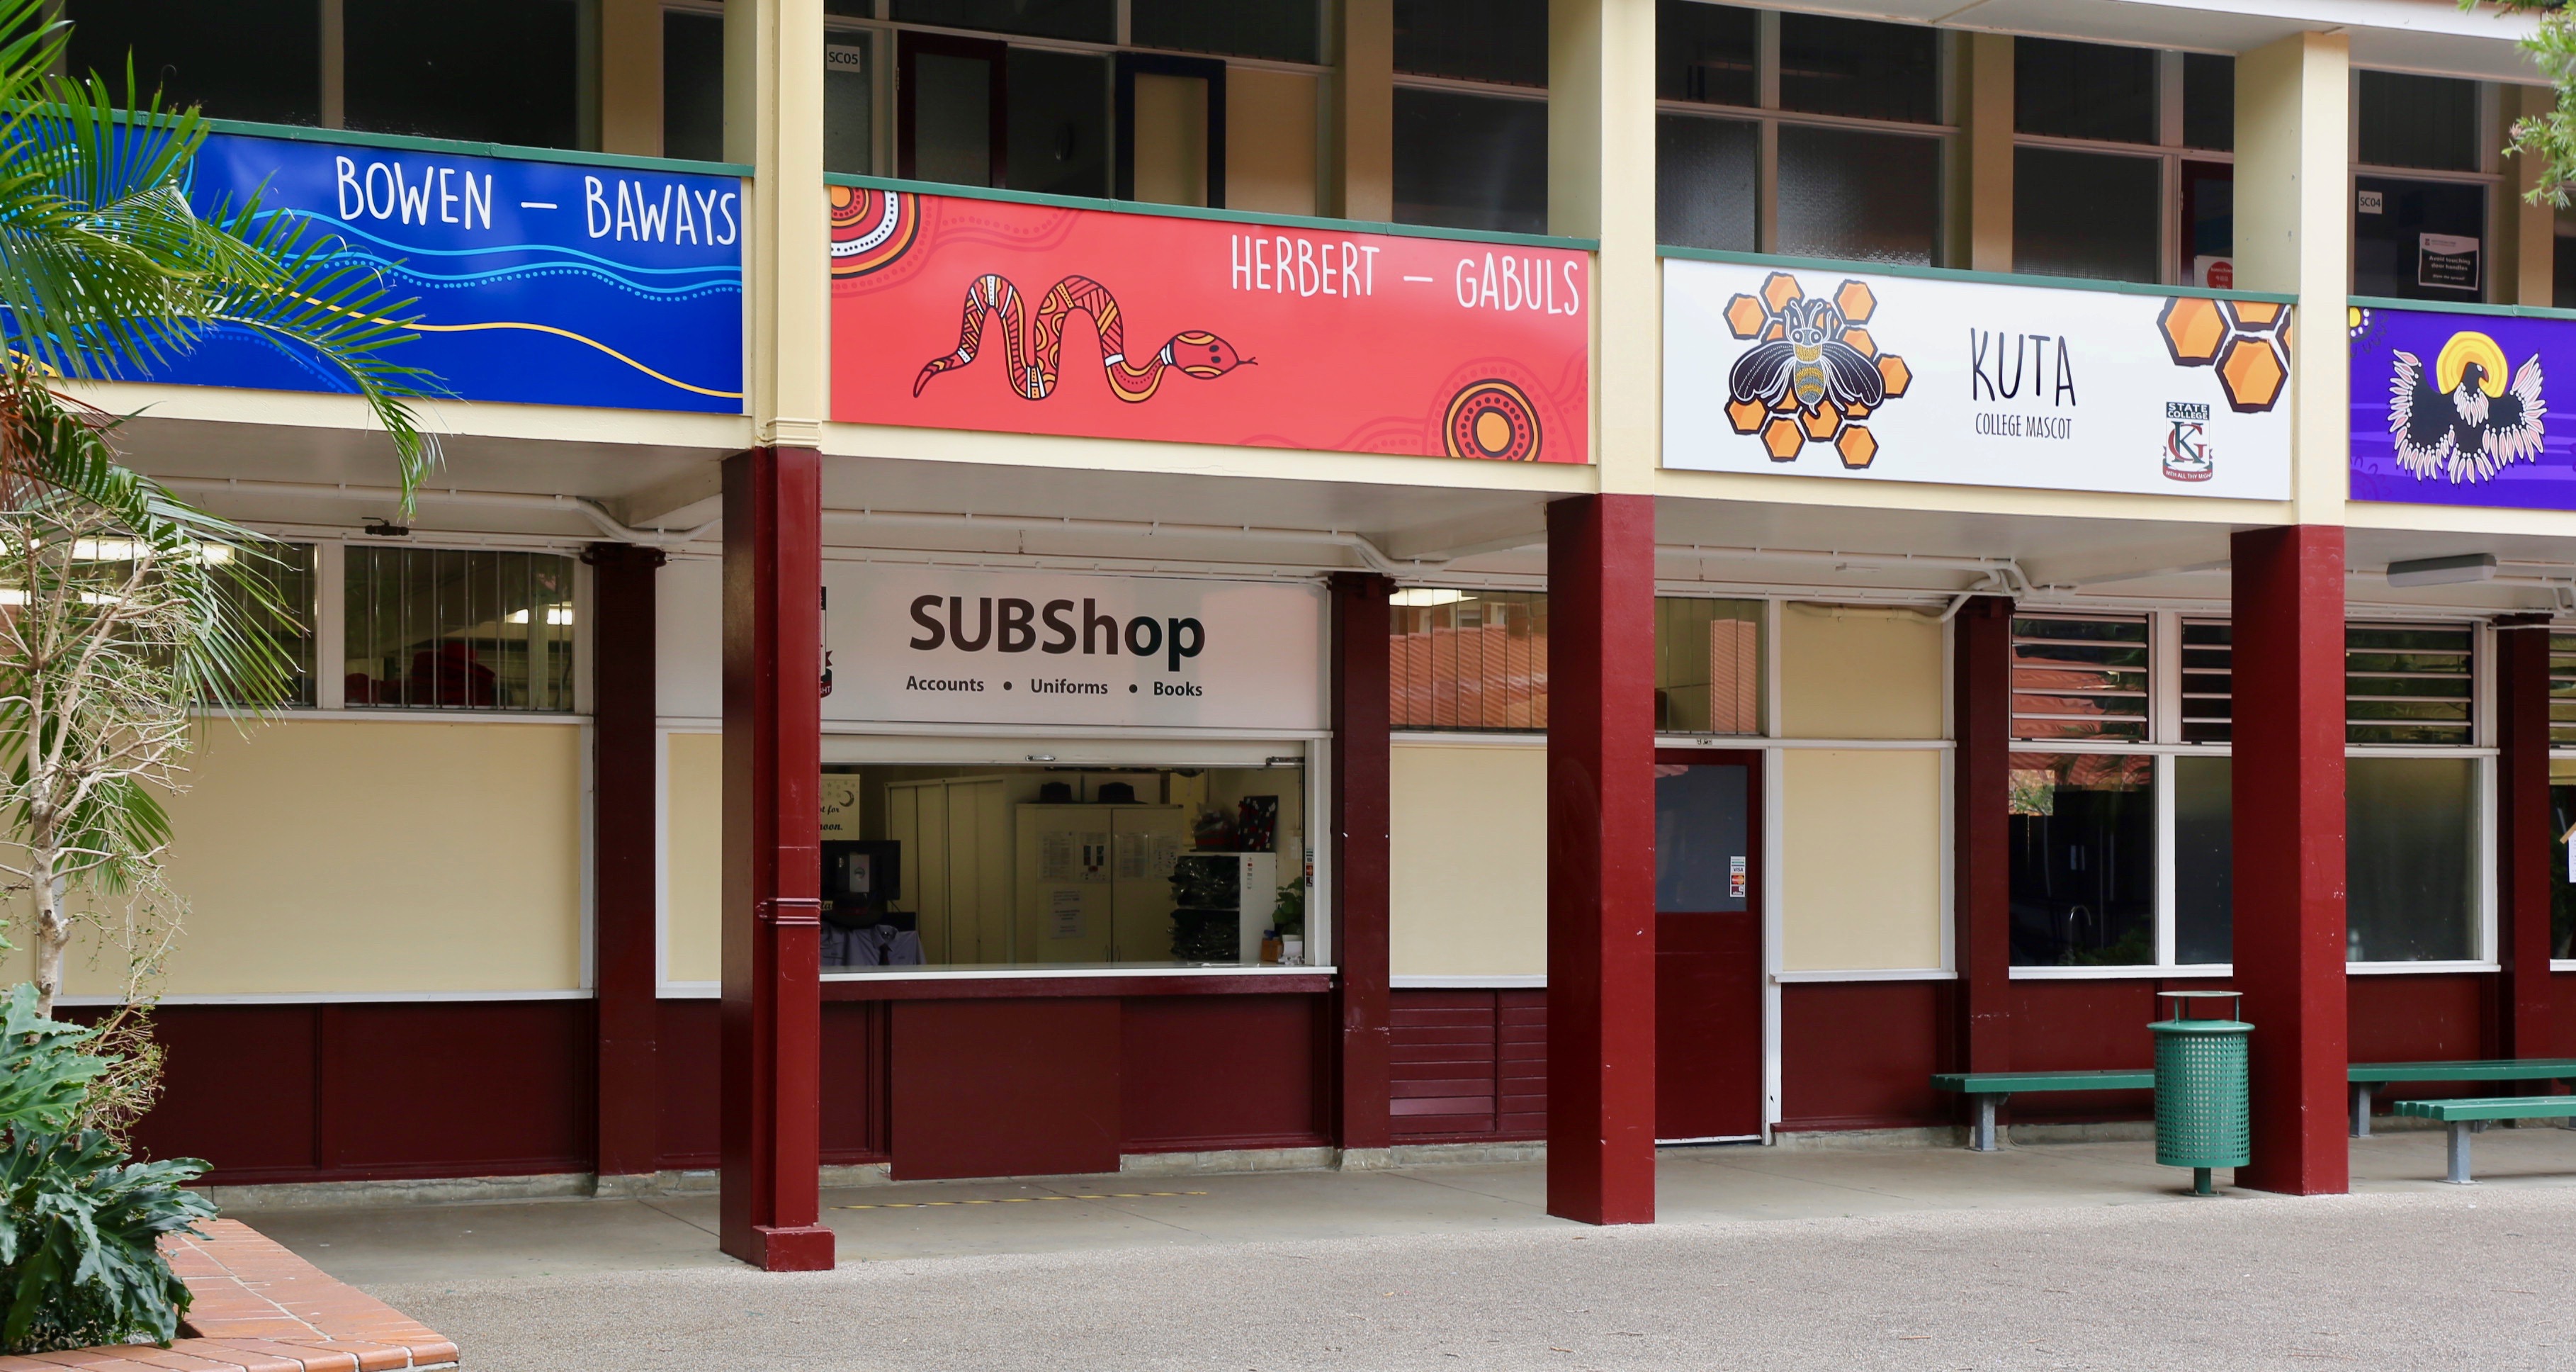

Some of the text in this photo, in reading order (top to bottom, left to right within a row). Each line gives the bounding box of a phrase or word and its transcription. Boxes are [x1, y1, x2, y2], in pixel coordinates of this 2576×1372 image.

[829, 51, 859, 64] SC05
[336, 156, 492, 230] BOWEN
[584, 175, 736, 246] BAWAYS
[2360, 196, 2381, 208] SC04
[2446, 257, 2471, 266] touching
[1231, 234, 1380, 298] HERBERT
[1455, 252, 1579, 316] GABULS
[1970, 327, 2076, 407] KUTA
[2167, 410, 2208, 420] COLLEGE
[2168, 402, 2208, 413] STATE
[1975, 412, 2072, 440] COLLEGE MASCOT
[910, 595, 1206, 672] SUBShop
[905, 675, 1203, 697] Accounts Uniforms Books
[827, 805, 840, 816] for
